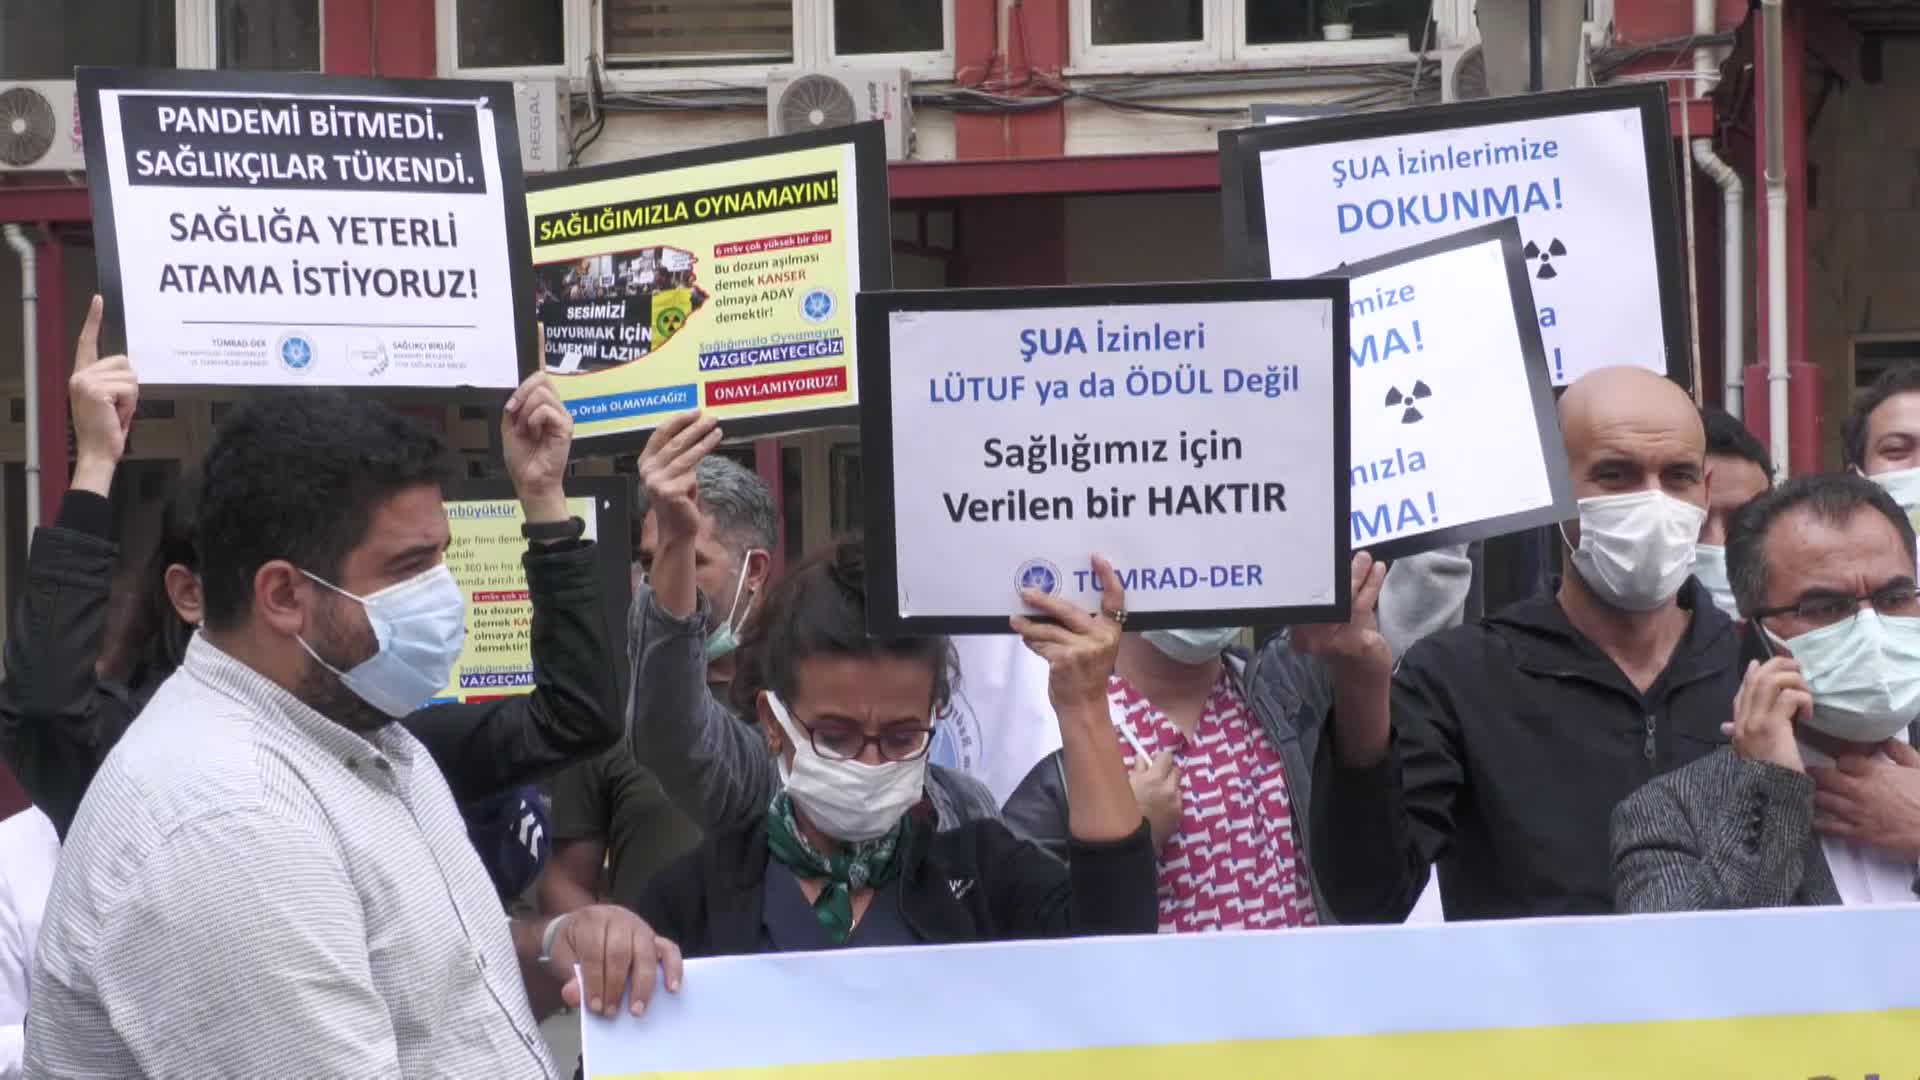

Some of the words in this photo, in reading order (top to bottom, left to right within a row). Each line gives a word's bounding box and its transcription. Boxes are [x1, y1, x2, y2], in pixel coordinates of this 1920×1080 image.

[158, 105, 300, 136] PANDEMİ
[311, 105, 444, 141] BİTMEDİ.
[529, 89, 541, 160] REGAL
[136, 145, 327, 185] SAĞLIKÇILAR
[334, 152, 475, 185] TÜKENDİ.
[1332, 154, 1391, 188] ŞUA
[1398, 136, 1560, 177] İzinlerimize
[540, 202, 688, 241] SAĞLIĞIMIZLA
[694, 176, 839, 218] OYNAMAYIN!
[1337, 177, 1564, 235] DOKUNMA!
[169, 206, 319, 244] SAĞLIĞA
[327, 212, 457, 247] YETERLİ
[763, 237, 796, 251] yüksek
[797, 235, 809, 245] bir
[811, 232, 829, 242] doz
[715, 264, 729, 275] Bu
[733, 258, 769, 273] dozun
[771, 252, 819, 270] aşılması
[159, 264, 282, 295] ATAMA
[293, 260, 479, 299] İSTİYORUZ!
[715, 278, 755, 291] demek
[757, 270, 807, 286] KANSER
[567, 300, 626, 320] SESİMİZİ
[715, 292, 757, 308] olmaya
[761, 288, 795, 302] ADAY
[715, 307, 773, 324] demektir!
[546, 325, 615, 340] DUYURMAK
[620, 323, 652, 345] İÇİN
[1020, 326, 1087, 362] ŞUA
[1097, 320, 1206, 354] İzinleri
[699, 336, 844, 369] VAZGEÇMEYECEĞİZ!
[714, 373, 838, 401] ONAYLAMIYORUZ!
[929, 371, 1026, 404] LÜTUF
[1035, 380, 1069, 406] ya
[1079, 372, 1116, 399] da
[1126, 363, 1213, 397] ÖDÜL
[1223, 366, 1299, 399] Değil
[579, 402, 607, 416] Ortak
[609, 391, 687, 413] OLMAYACAĞIZ!
[983, 433, 1168, 474] Sağlığımız
[1179, 429, 1242, 468] için
[943, 489, 1074, 523] Verilen
[1086, 486, 1136, 519] bir
[1147, 481, 1287, 517] HAKTIR
[473, 606, 488, 616] Bu
[490, 605, 524, 616] dozun
[474, 618, 511, 629] demek
[474, 631, 514, 642] olmaya
[475, 642, 528, 653] demektir!
